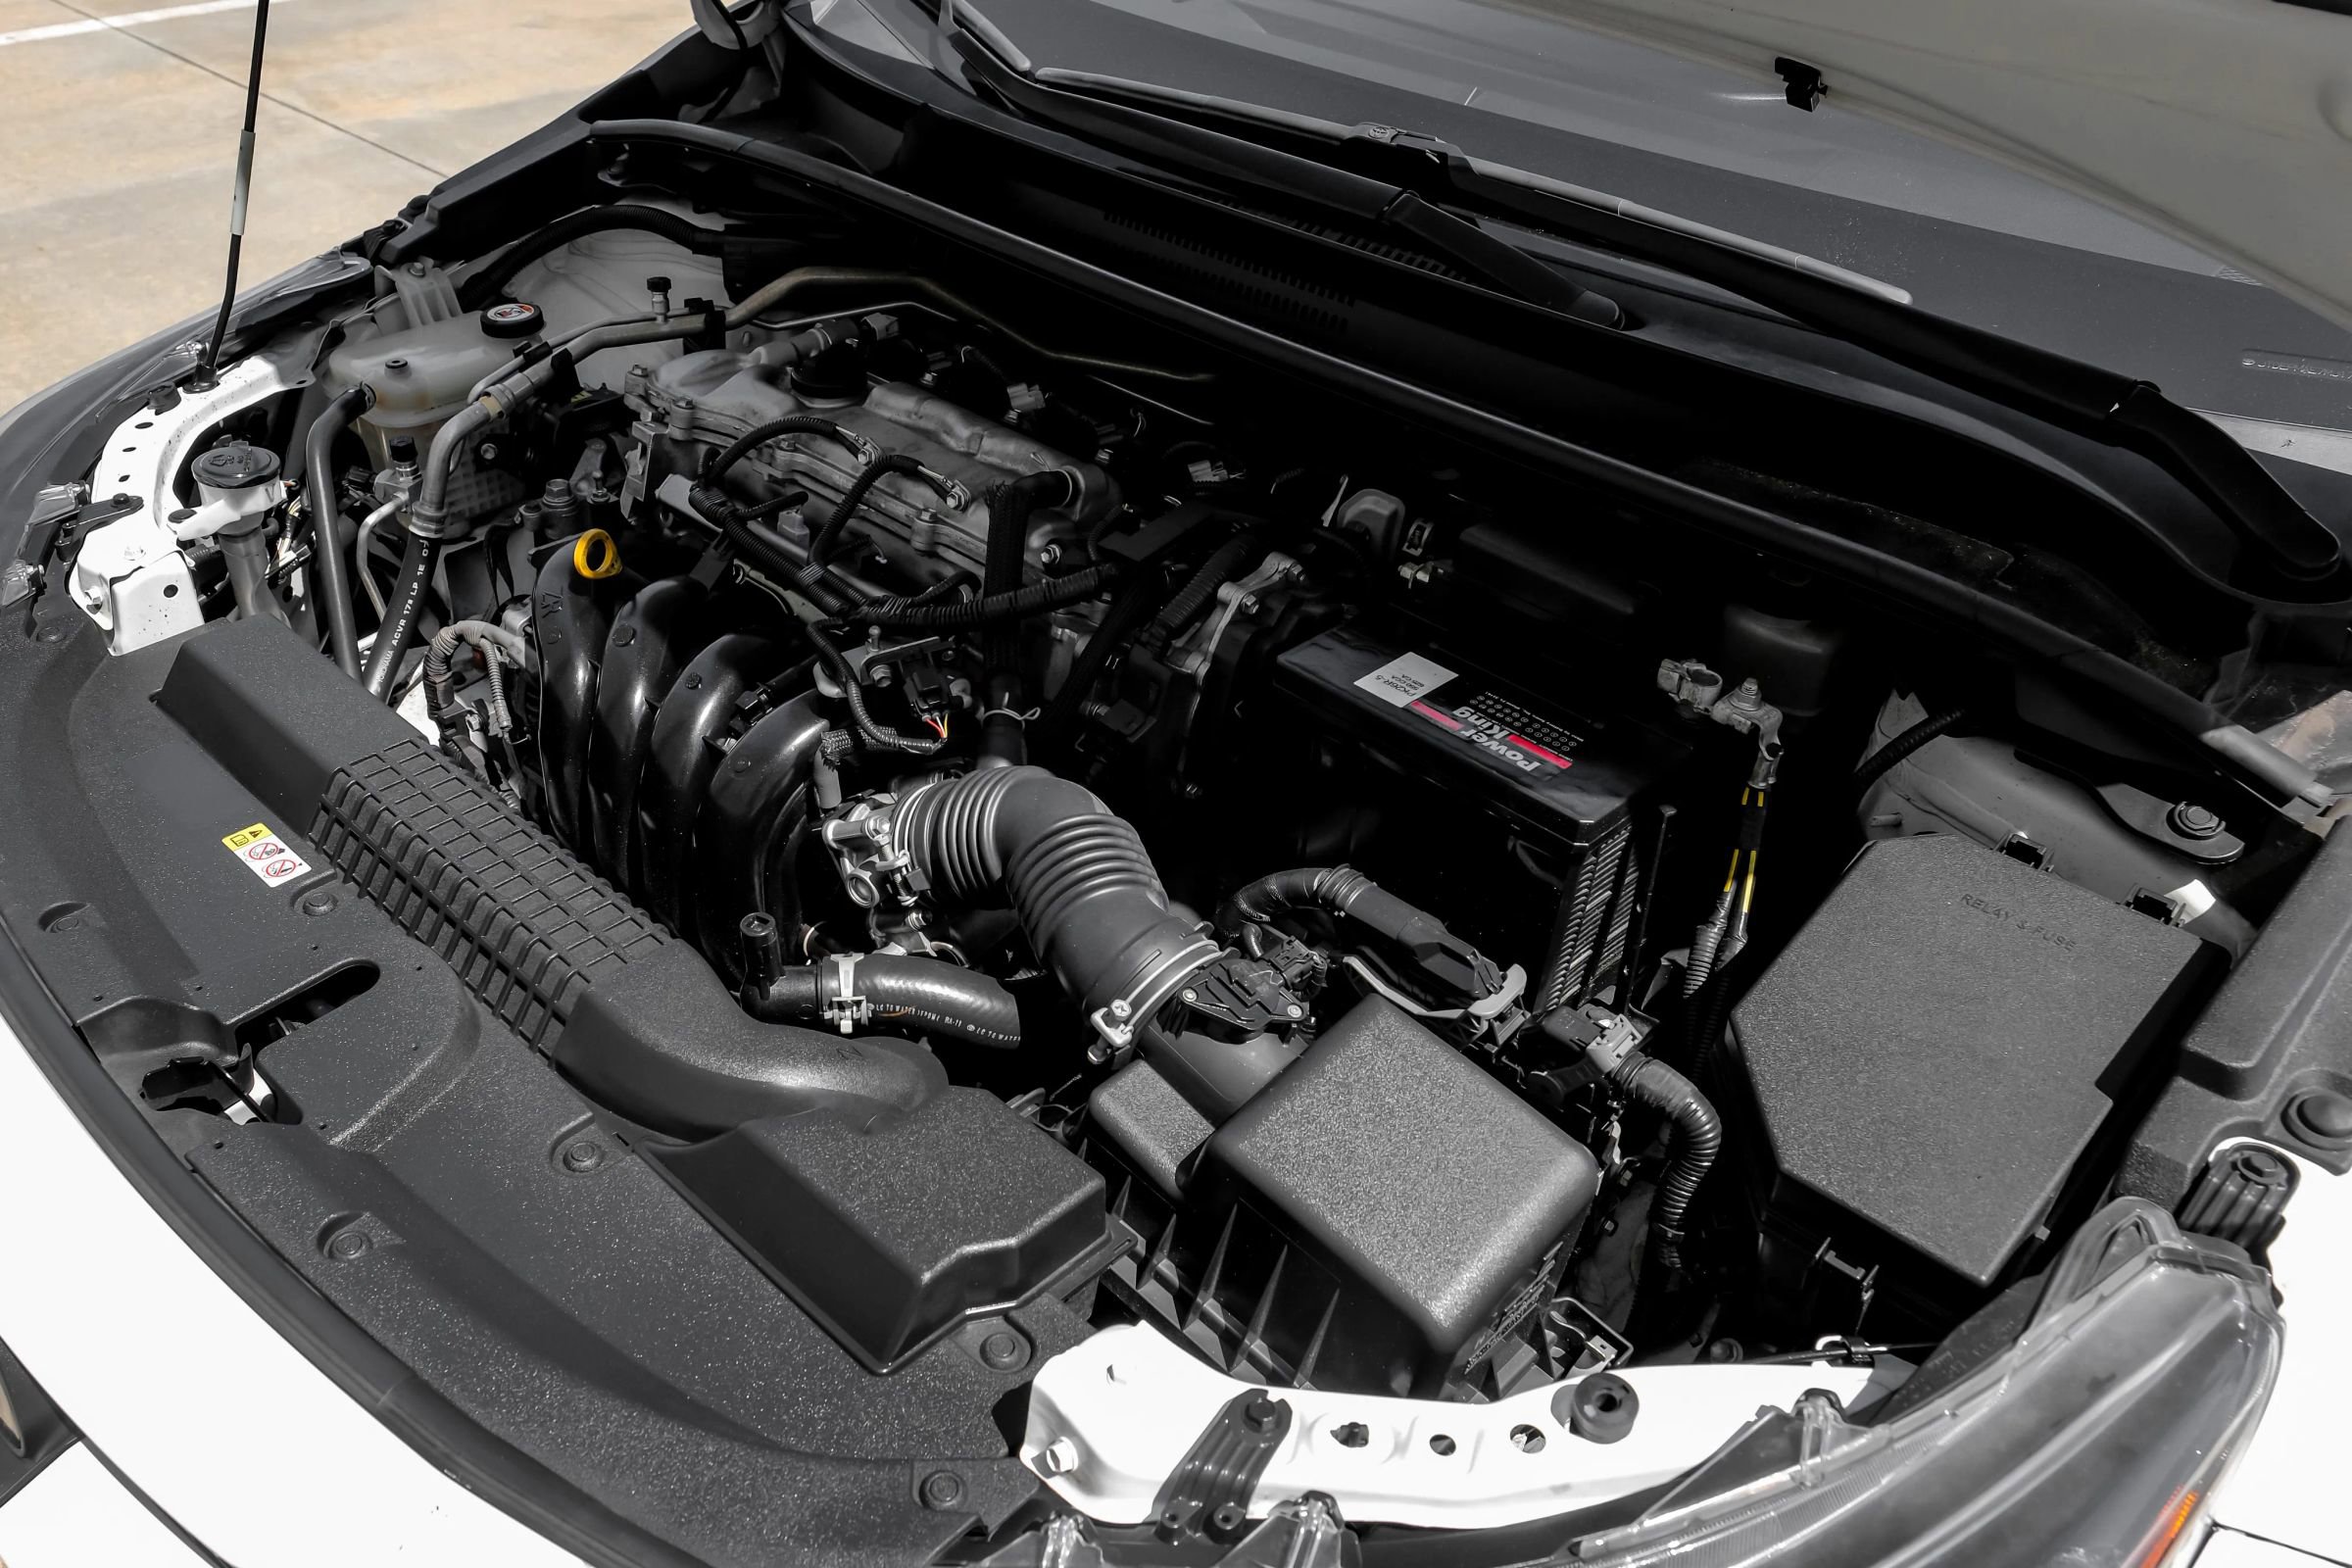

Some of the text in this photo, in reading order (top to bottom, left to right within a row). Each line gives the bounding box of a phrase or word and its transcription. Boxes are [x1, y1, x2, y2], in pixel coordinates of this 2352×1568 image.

[392, 618, 407, 647] ACVR
[410, 581, 418, 596] LP
[1375, 674, 1417, 697] PK26R-5
[1452, 706, 1510, 740] King
[1460, 728, 1542, 772] Power
[1961, 893, 2010, 921] RELAY
[896, 1004, 915, 1015] WATER
